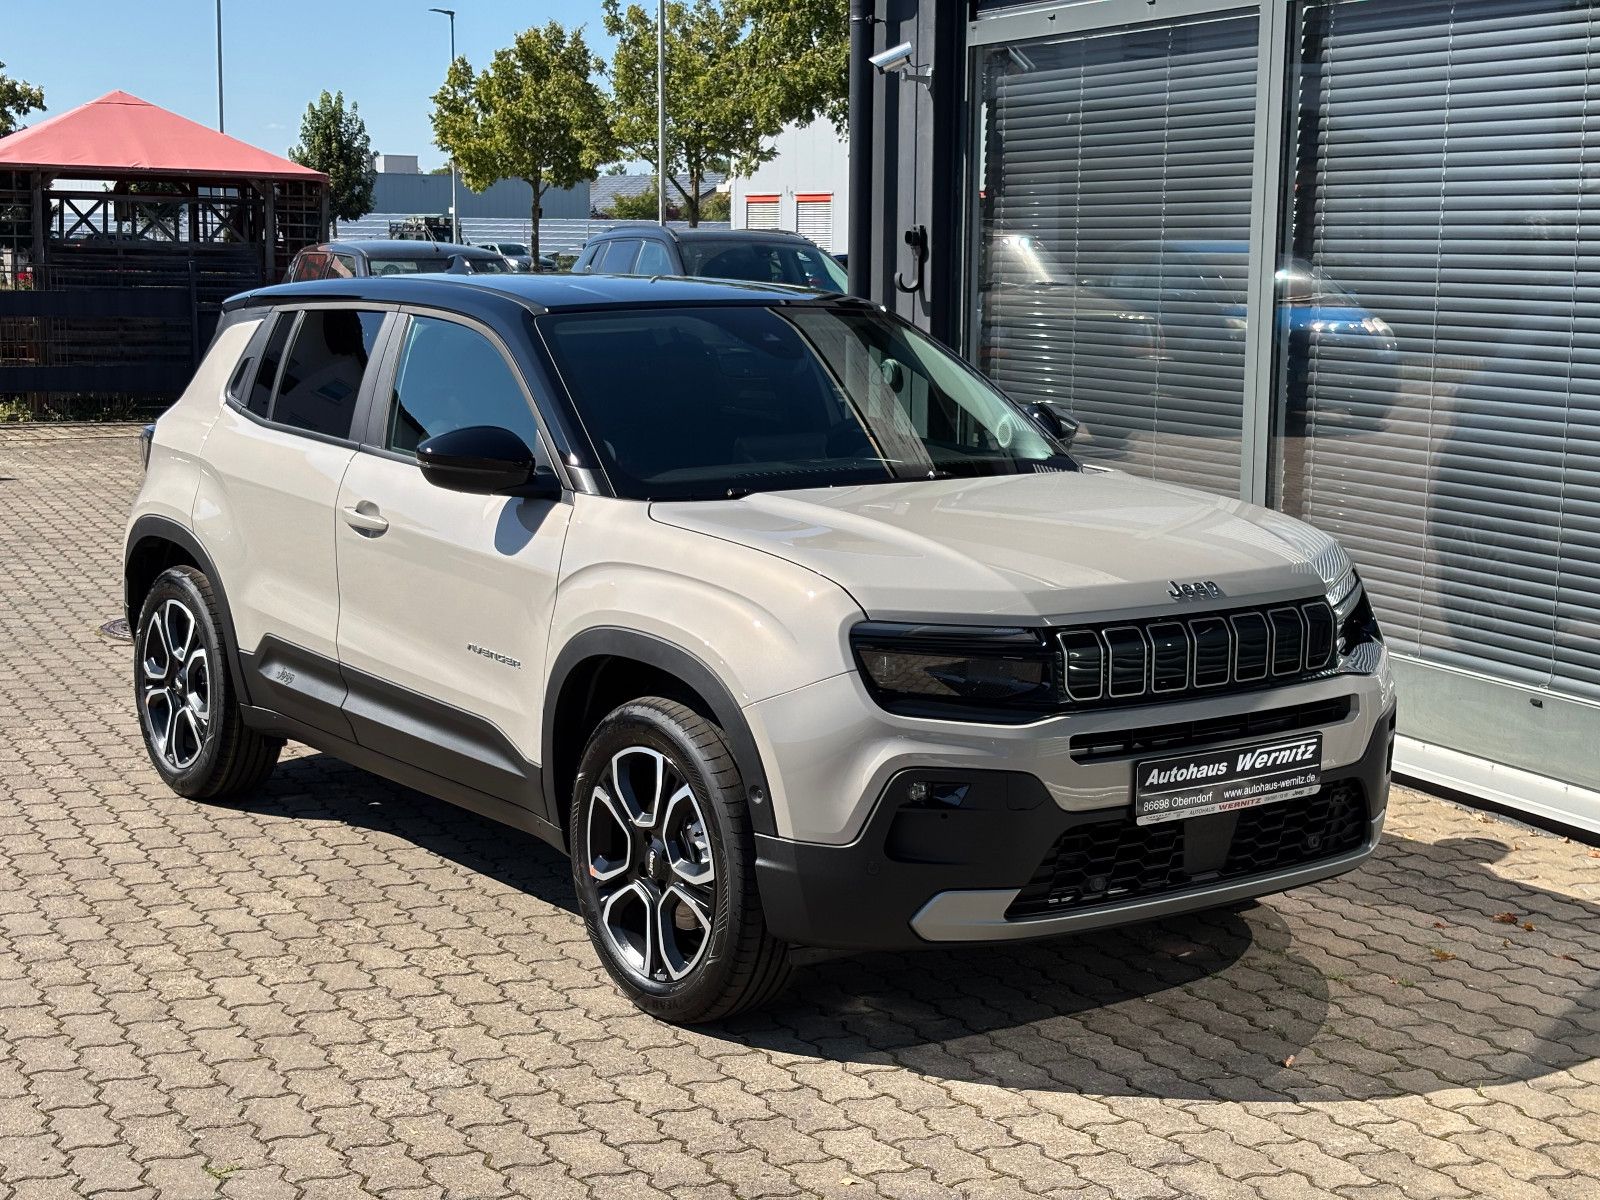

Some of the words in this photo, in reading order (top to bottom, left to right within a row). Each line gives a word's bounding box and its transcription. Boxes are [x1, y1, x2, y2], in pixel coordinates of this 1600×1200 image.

[1166, 580, 1218, 599] Jeep
[467, 642, 521, 670] AVENGER
[1145, 761, 1228, 786] Autohaus
[1236, 740, 1318, 773] Wernitz
[1143, 798, 1169, 812] 86698
[1172, 791, 1213, 808] Oberndorf
[1223, 773, 1316, 798] www.autohaus-wernitz.de
[1218, 797, 1263, 811] WERNITZ
